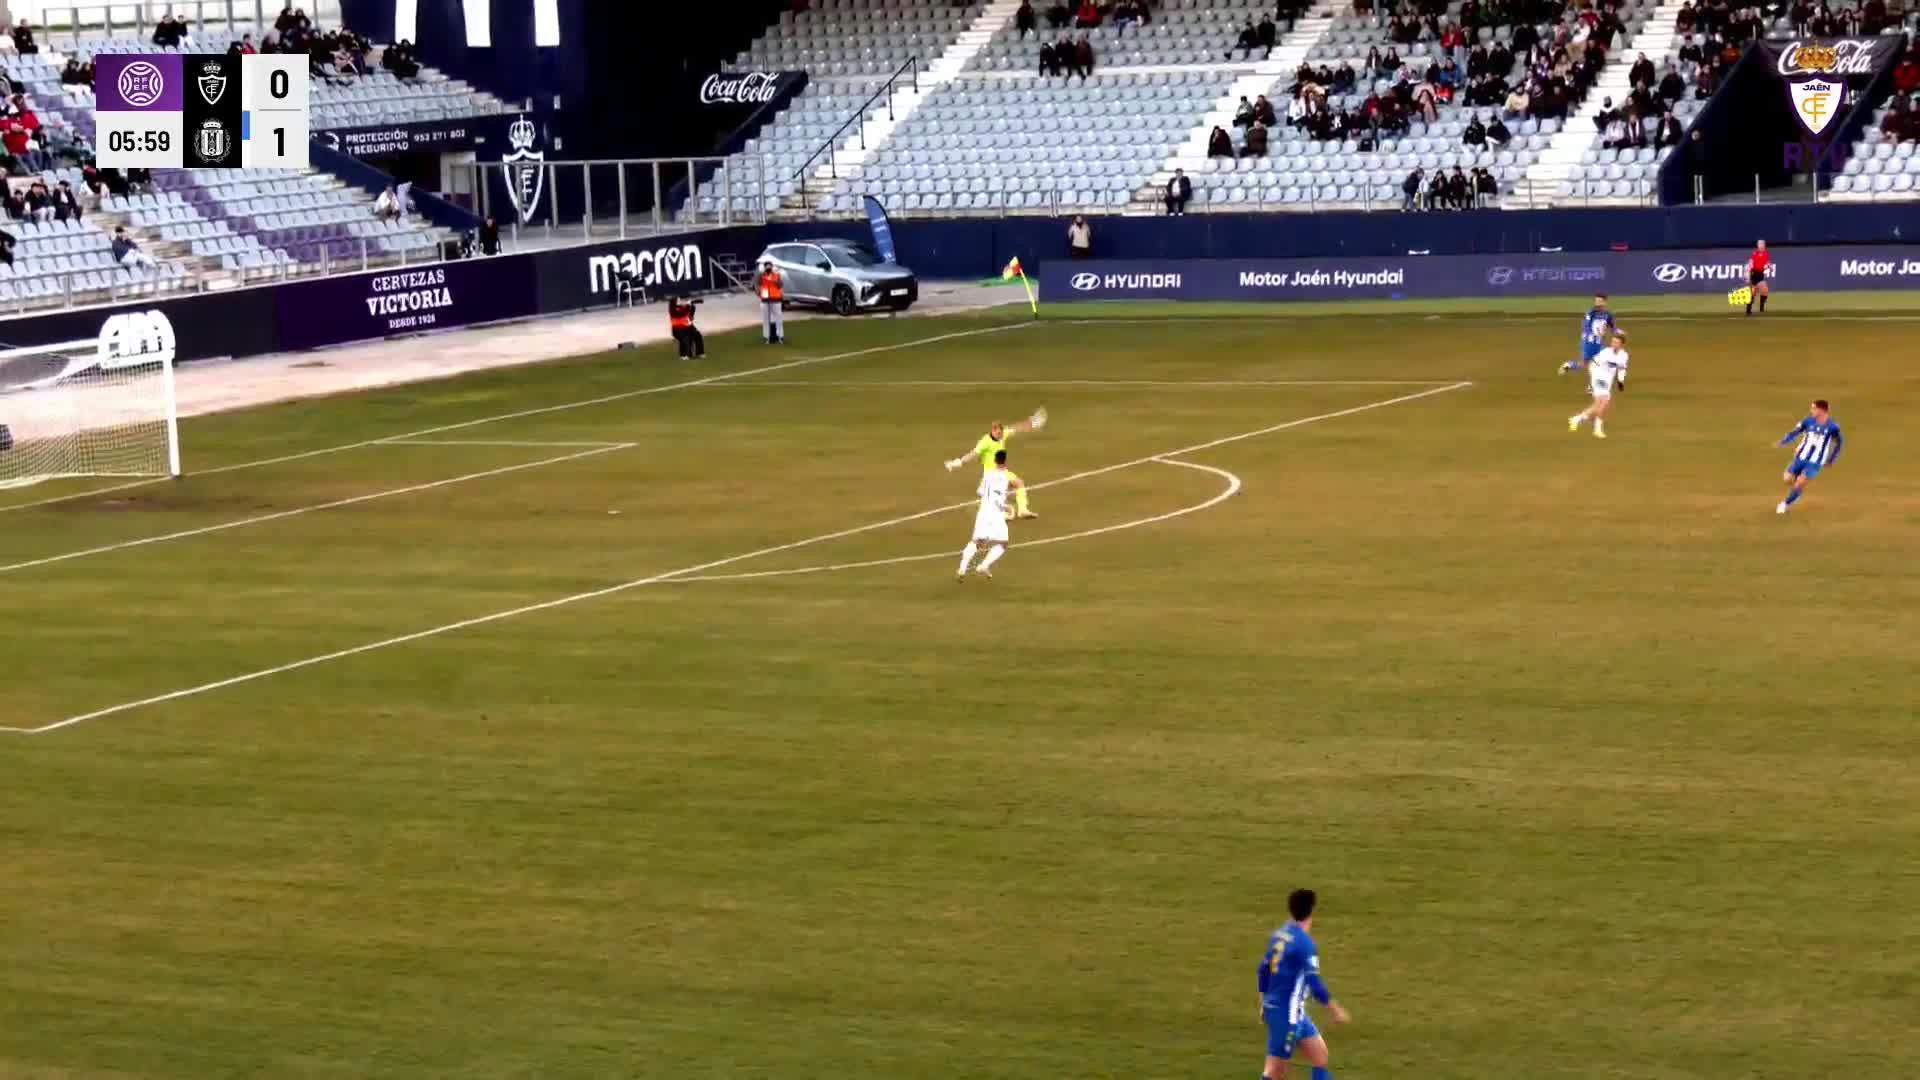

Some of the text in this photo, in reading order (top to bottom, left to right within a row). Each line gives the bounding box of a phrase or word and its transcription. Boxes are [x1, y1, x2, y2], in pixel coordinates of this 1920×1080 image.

[700, 72, 779, 104] Coca-Cola
[345, 129, 408, 144] PROTECCIÓN
[589, 245, 703, 293] macron
[1240, 268, 1404, 288] Motor Jaén Hyundai
[1841, 260, 1895, 276] Motor
[372, 269, 445, 292] CERVEZAS
[1104, 273, 1181, 289] HYUNDAI
[366, 287, 453, 316] VICTORIA
